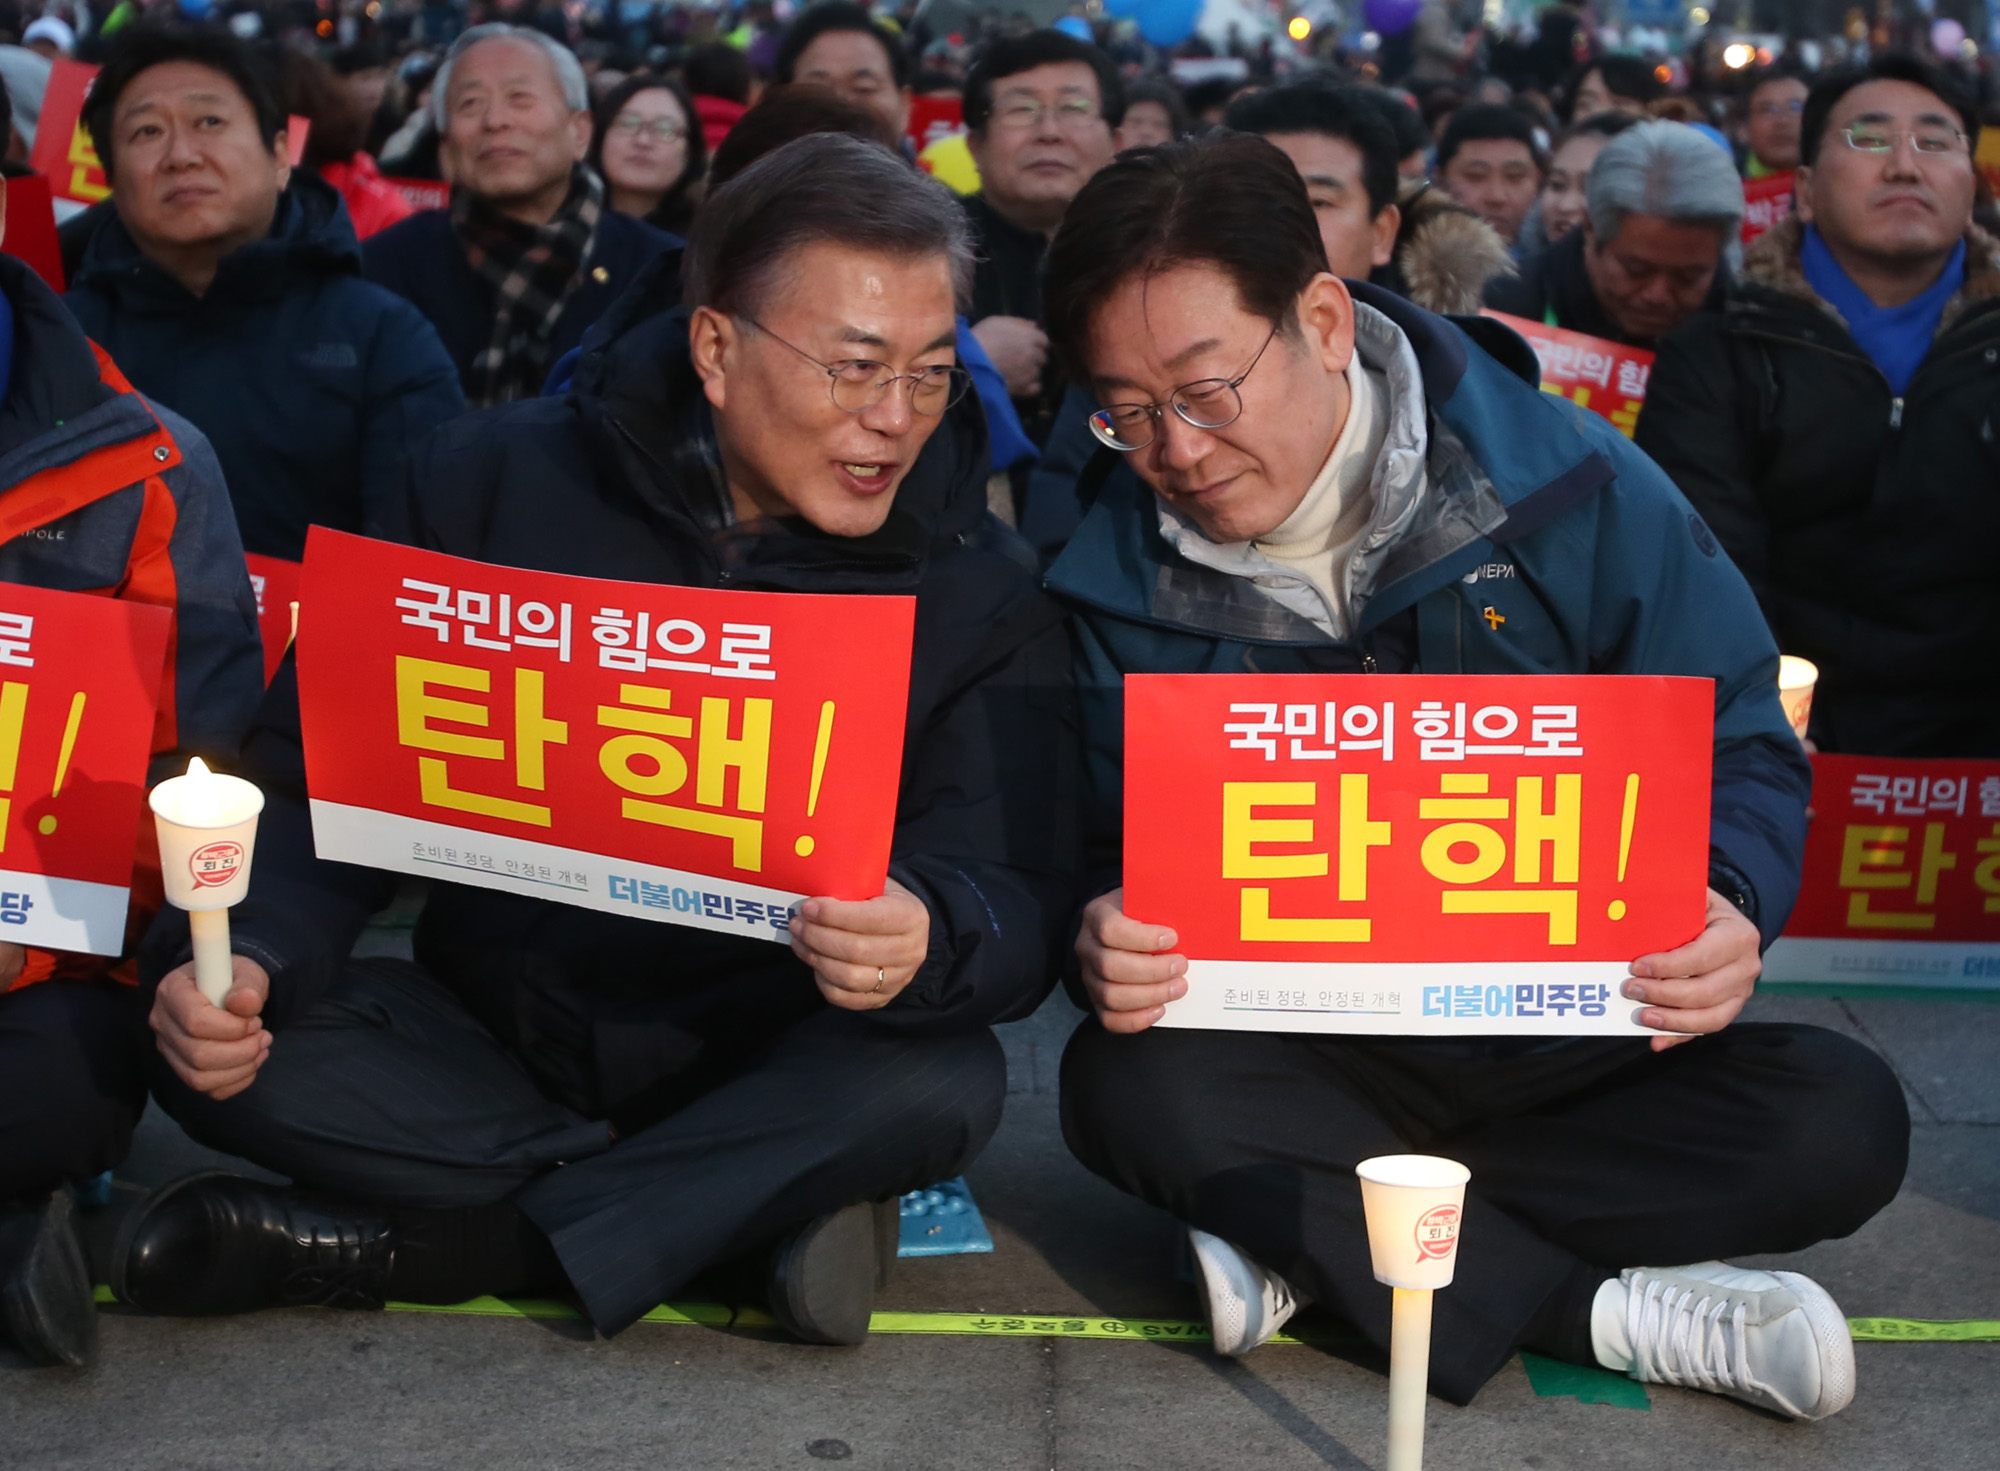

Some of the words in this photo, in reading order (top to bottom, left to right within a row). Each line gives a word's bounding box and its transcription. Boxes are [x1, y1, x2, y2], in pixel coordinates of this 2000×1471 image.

[21, 529, 65, 540] POLE
[1478, 564, 1515, 578] NEPA
[395, 578, 572, 662] 국민의
[591, 607, 777, 680] 힘으로
[1223, 702, 1394, 761] 국민의
[1411, 702, 1584, 761] 힘으로
[395, 653, 838, 873] 탄핵!
[1850, 774, 1968, 816] 국민의
[412, 841, 457, 863] 준비된
[505, 859, 551, 880] 안정된
[558, 870, 588, 887] 개혁
[1222, 773, 1640, 945] 탄핵!
[1839, 822, 2000, 930] 탄
[608, 874, 797, 932] 더불어민주당
[1223, 988, 1270, 1005] 준비된
[1318, 991, 1365, 1008] 안정된
[1371, 992, 1401, 1009] 개혁
[1422, 983, 1612, 1017] 더불어민주당
